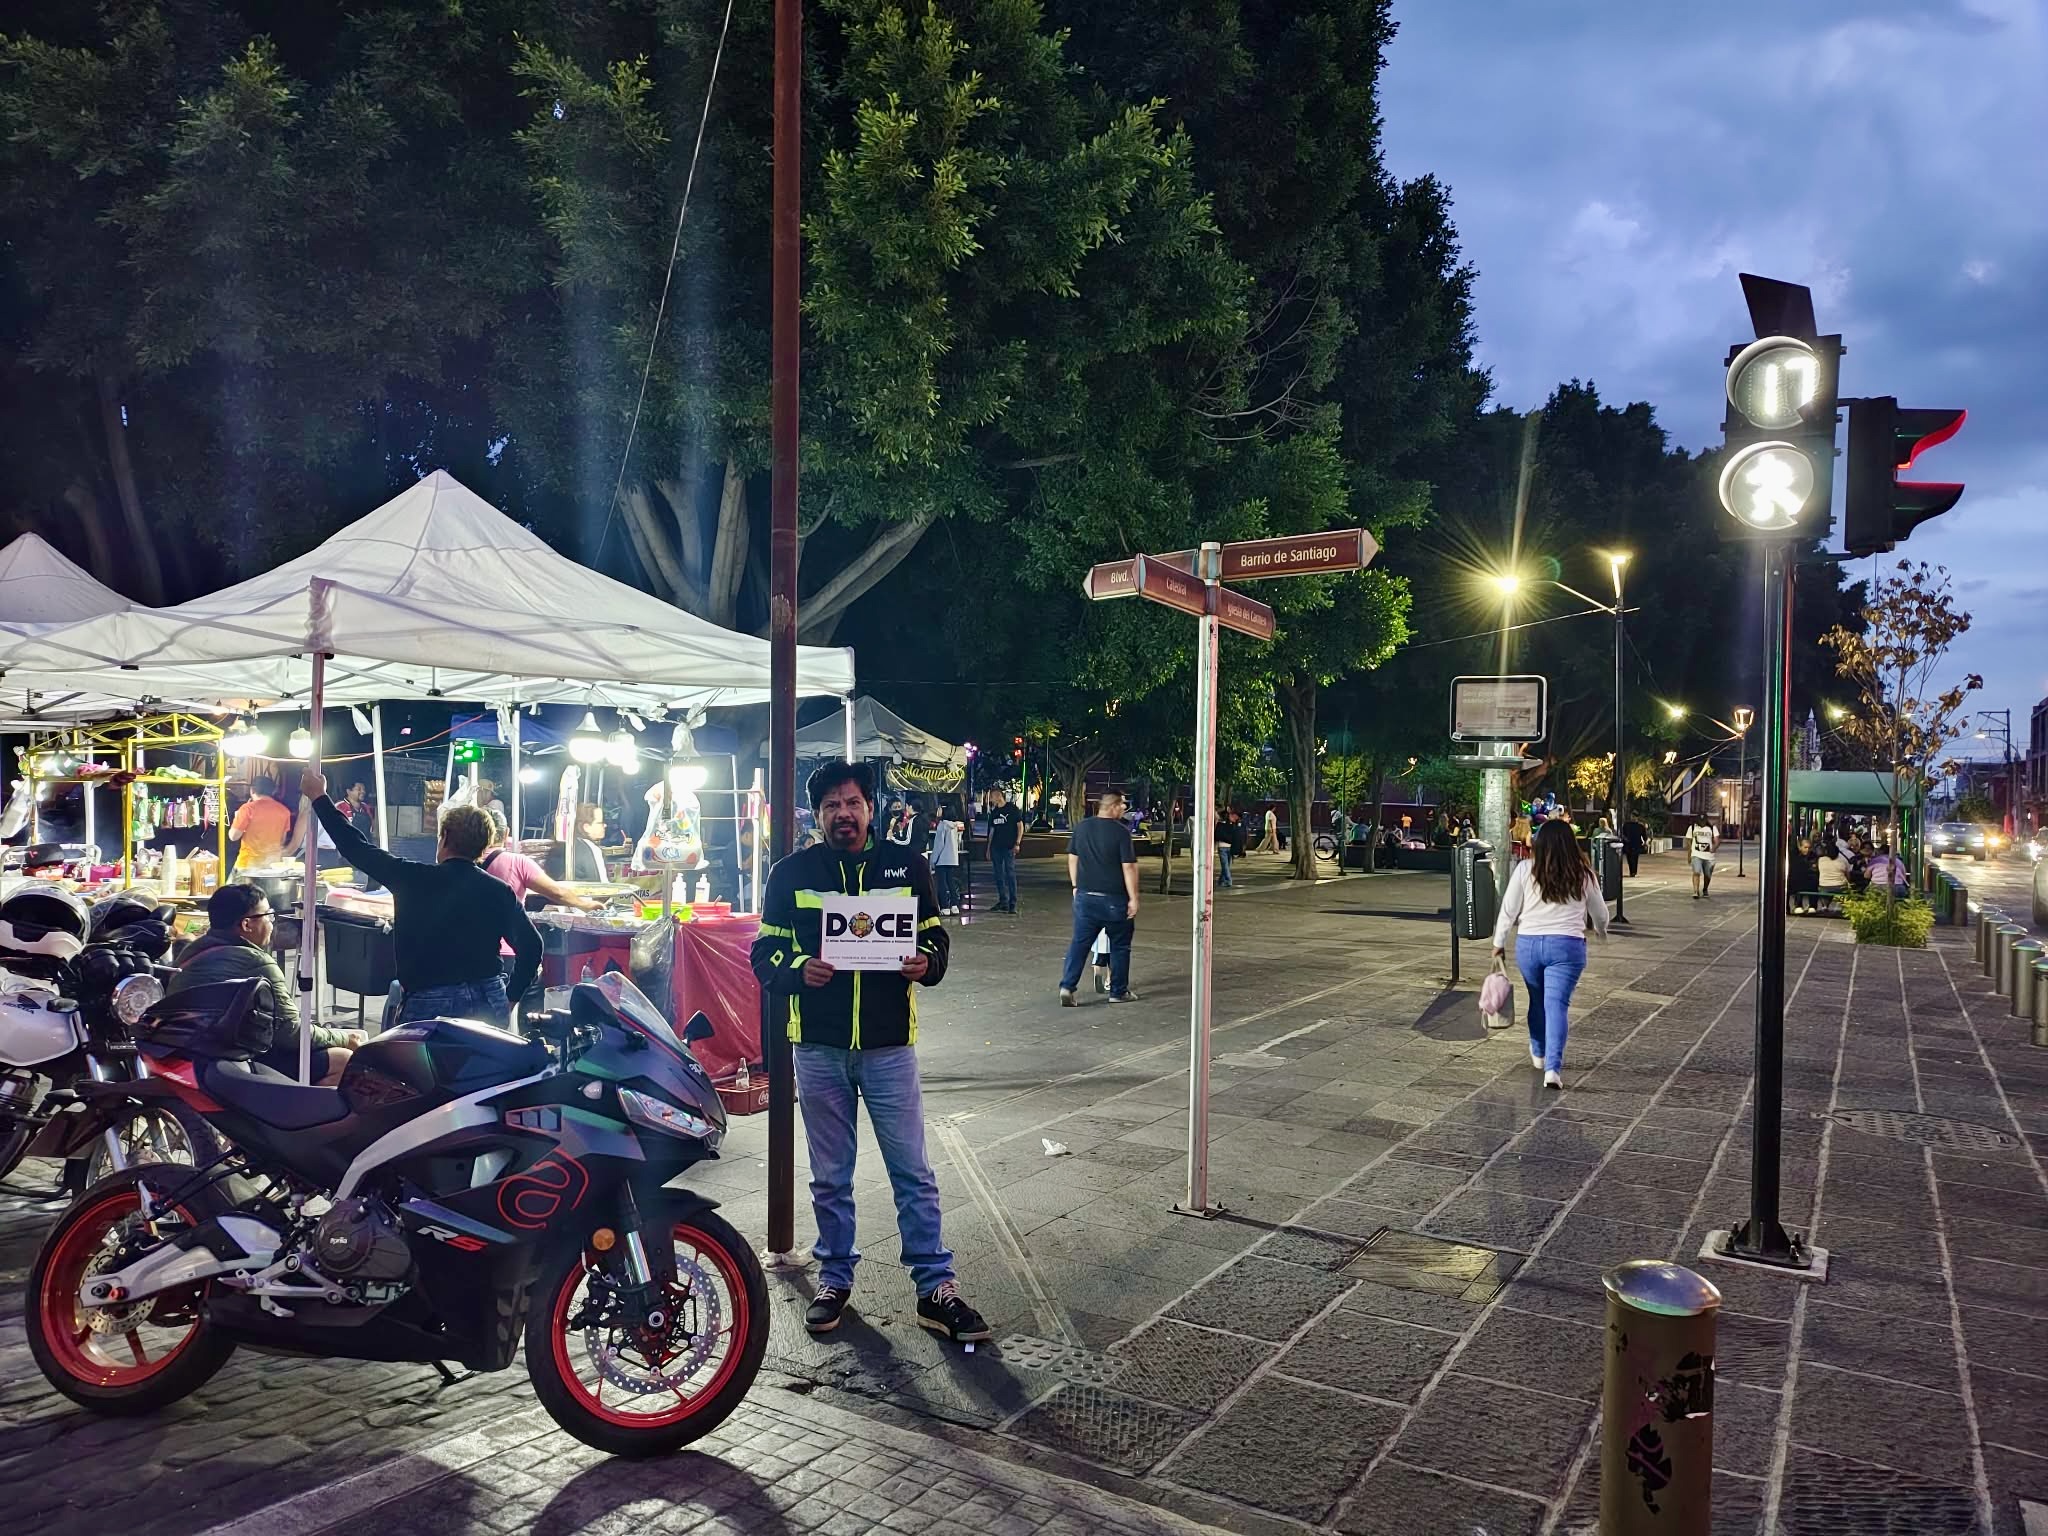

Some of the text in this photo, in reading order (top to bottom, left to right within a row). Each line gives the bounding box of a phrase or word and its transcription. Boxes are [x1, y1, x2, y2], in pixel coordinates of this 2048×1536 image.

[1240, 546, 1337, 567] Barrio de Santiago
[1110, 569, 1129, 584] Blvd.
[884, 867, 908, 878] HWK
[416, 1225, 488, 1251] RS
